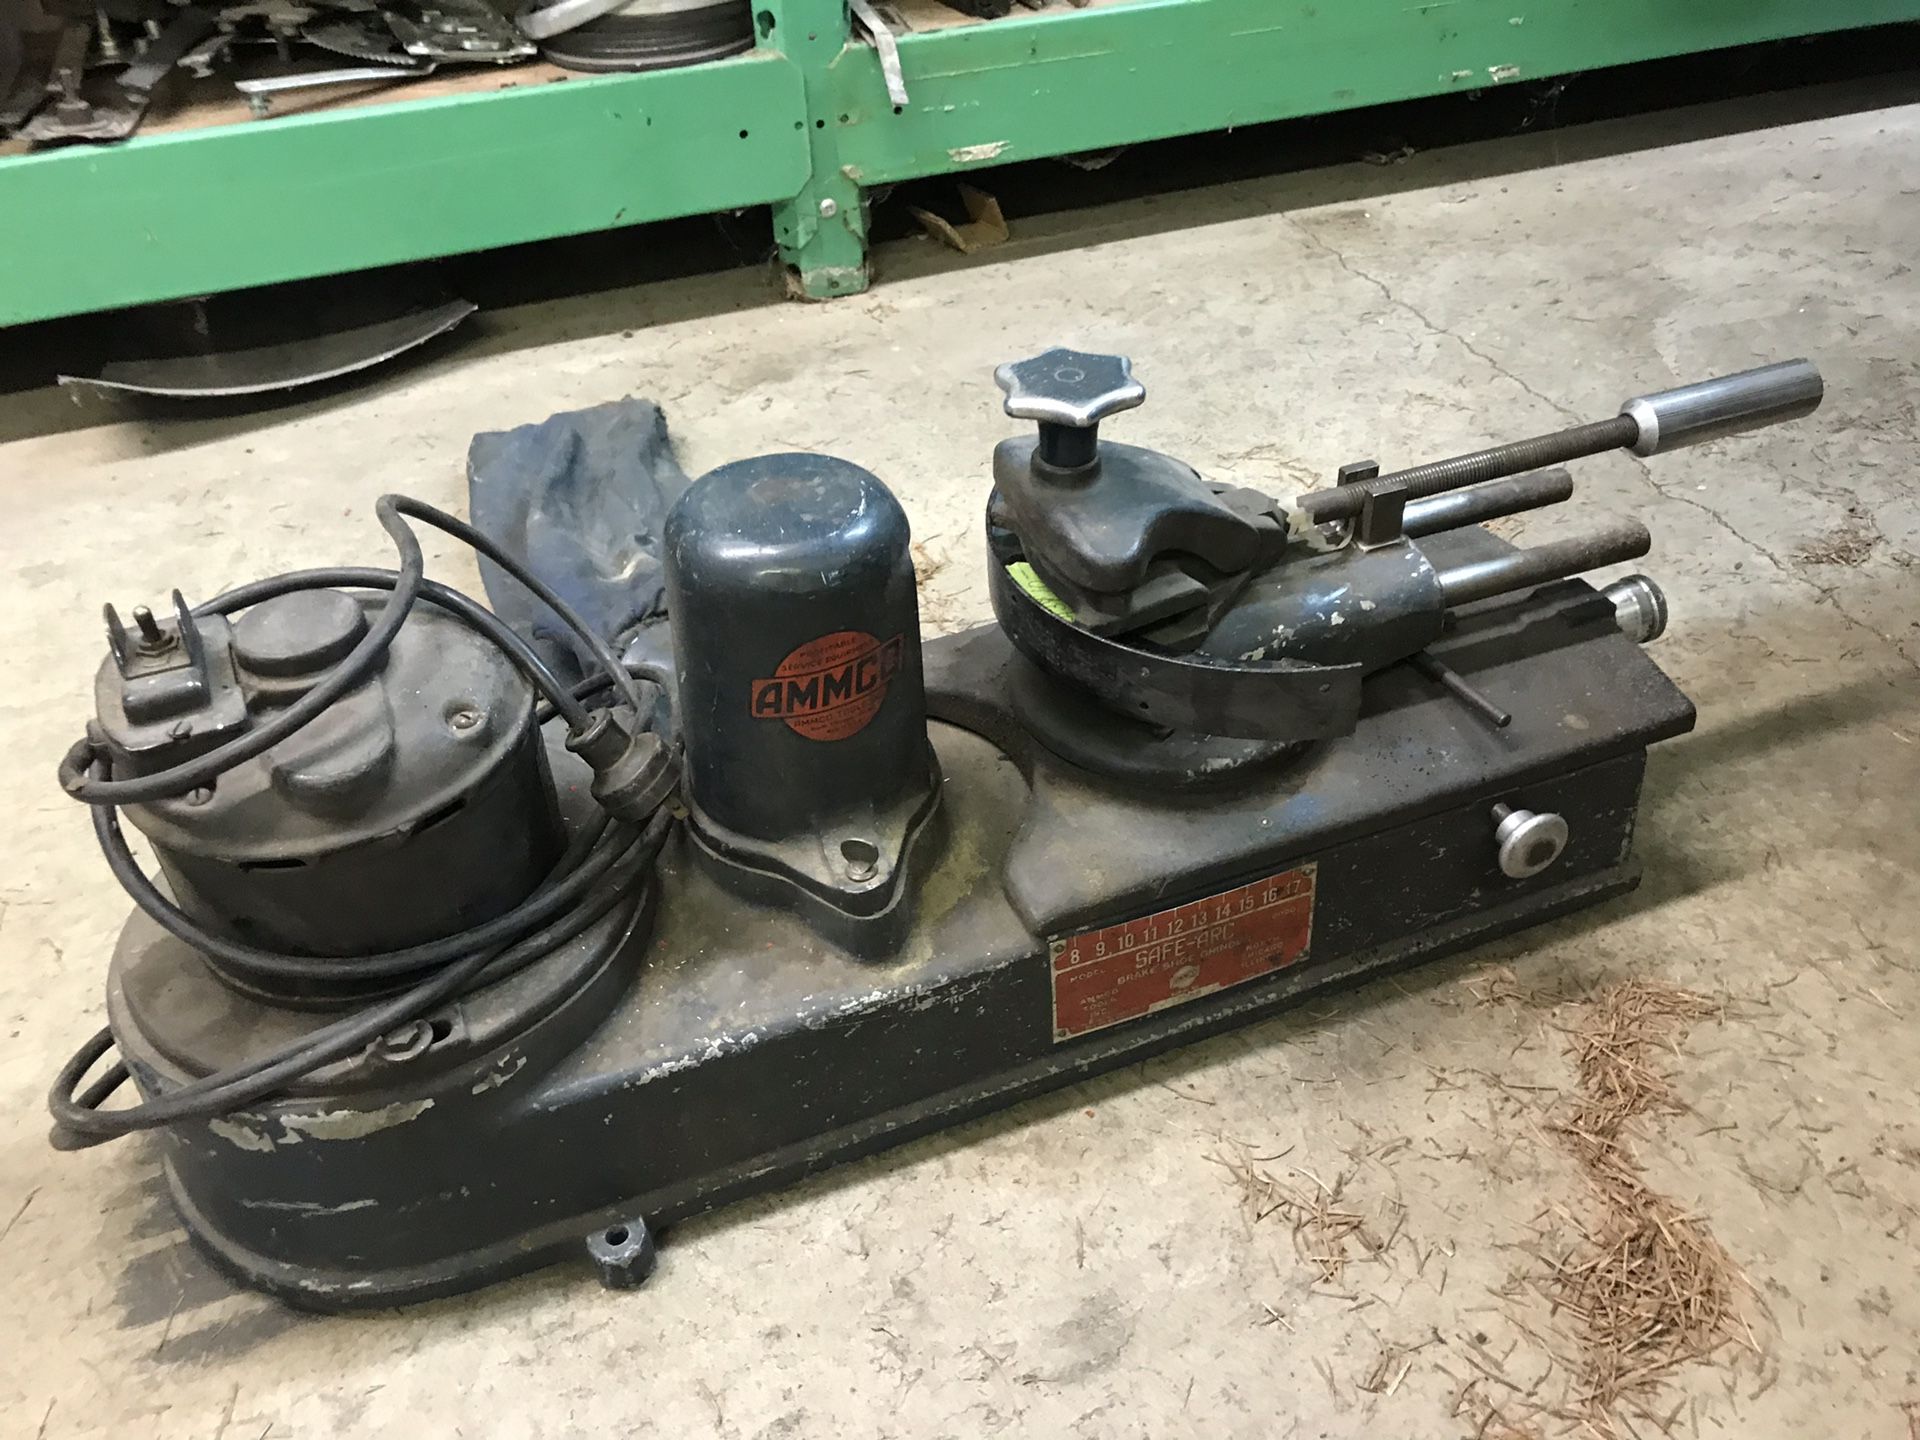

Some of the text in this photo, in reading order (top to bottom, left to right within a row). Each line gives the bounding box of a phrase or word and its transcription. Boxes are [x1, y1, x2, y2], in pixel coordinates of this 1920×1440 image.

[756, 638, 902, 715] AMMCO
[1070, 880, 1301, 964] 8 9 10 11 12 13 14 15 16 17
[1136, 922, 1236, 969] SAFE-ARC
